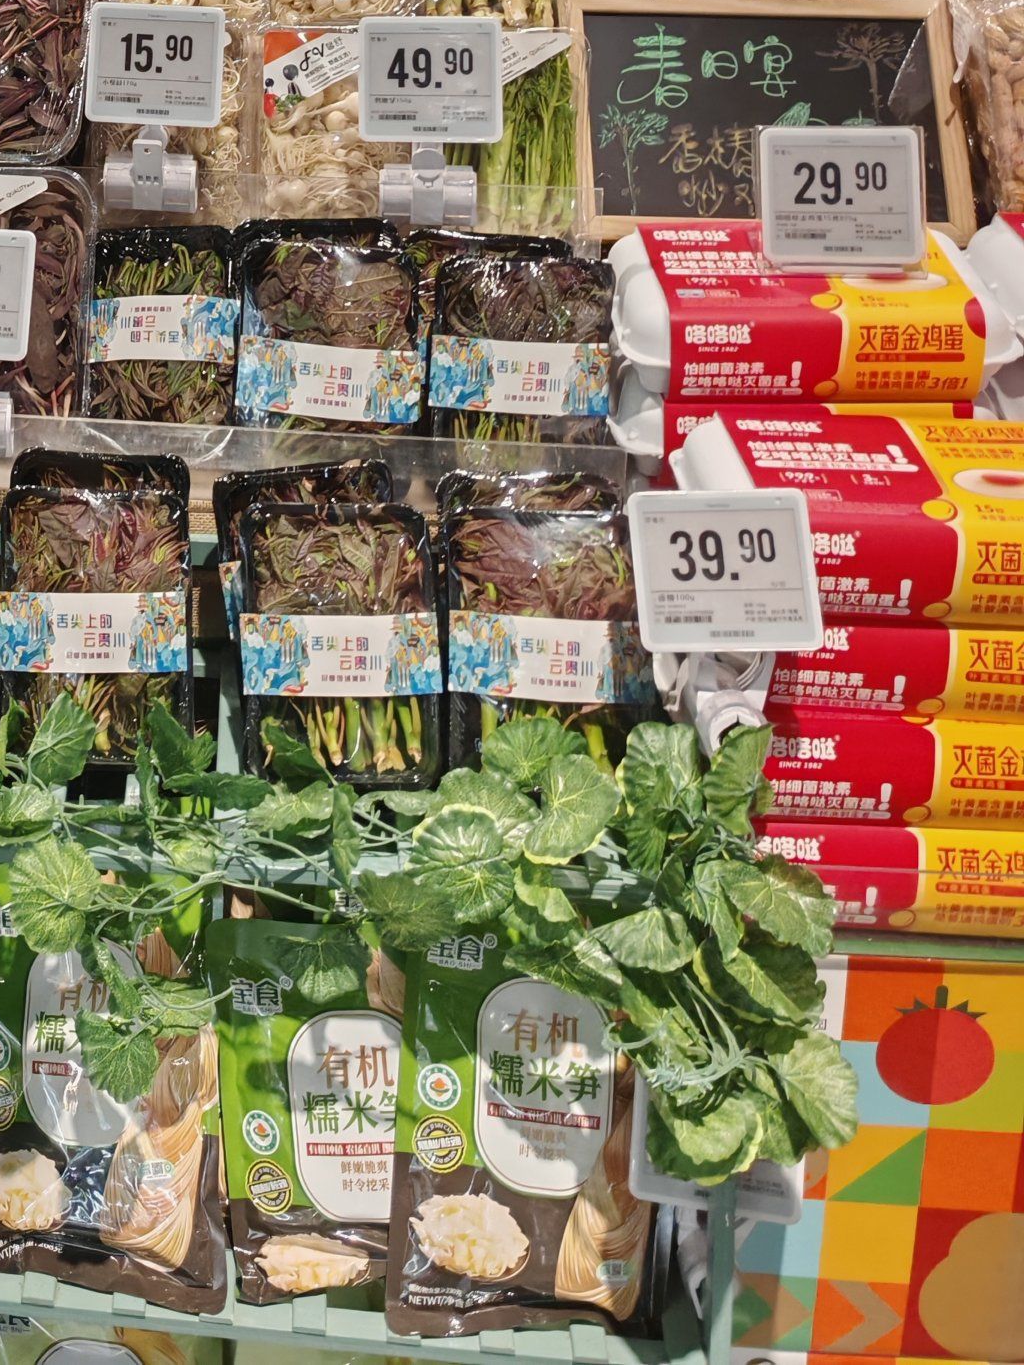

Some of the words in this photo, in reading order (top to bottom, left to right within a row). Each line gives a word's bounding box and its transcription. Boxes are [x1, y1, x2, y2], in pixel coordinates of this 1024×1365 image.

[120, 33, 194, 75] 15.90
[387, 47, 474, 89] 49.90
[793, 161, 887, 206] 29.90
[685, 324, 752, 344] 咯咯哒
[859, 324, 964, 351] 灭菌金鸡蛋
[299, 361, 353, 381] 舌尖上的
[496, 359, 550, 377] 舌尖上的
[323, 381, 364, 398] 云贵川
[521, 376, 561, 392] 云贵川
[669, 527, 777, 582] 39.90
[977, 541, 1024, 572] 灭菌
[56, 612, 113, 630] 舌尖上的
[83, 632, 126, 648] 云贵川
[311, 634, 369, 652] 舌尖上的
[520, 637, 580, 656] 舌尖上的
[339, 654, 383, 671] 云贵川
[549, 659, 594, 676] 云贵川
[779, 761, 802, 770] SINCE
[804, 761, 823, 770] 1982
[953, 745, 1024, 777] 灭菌金
[937, 846, 1024, 882] 灭菌金鸡
[508, 1008, 583, 1058] 有机
[319, 1045, 395, 1091] 有机
[489, 1049, 602, 1105] 糯米笋
[340, 1160, 388, 1175] 鲜嫩脆爽
[342, 1178, 390, 1192] 时令挖采
